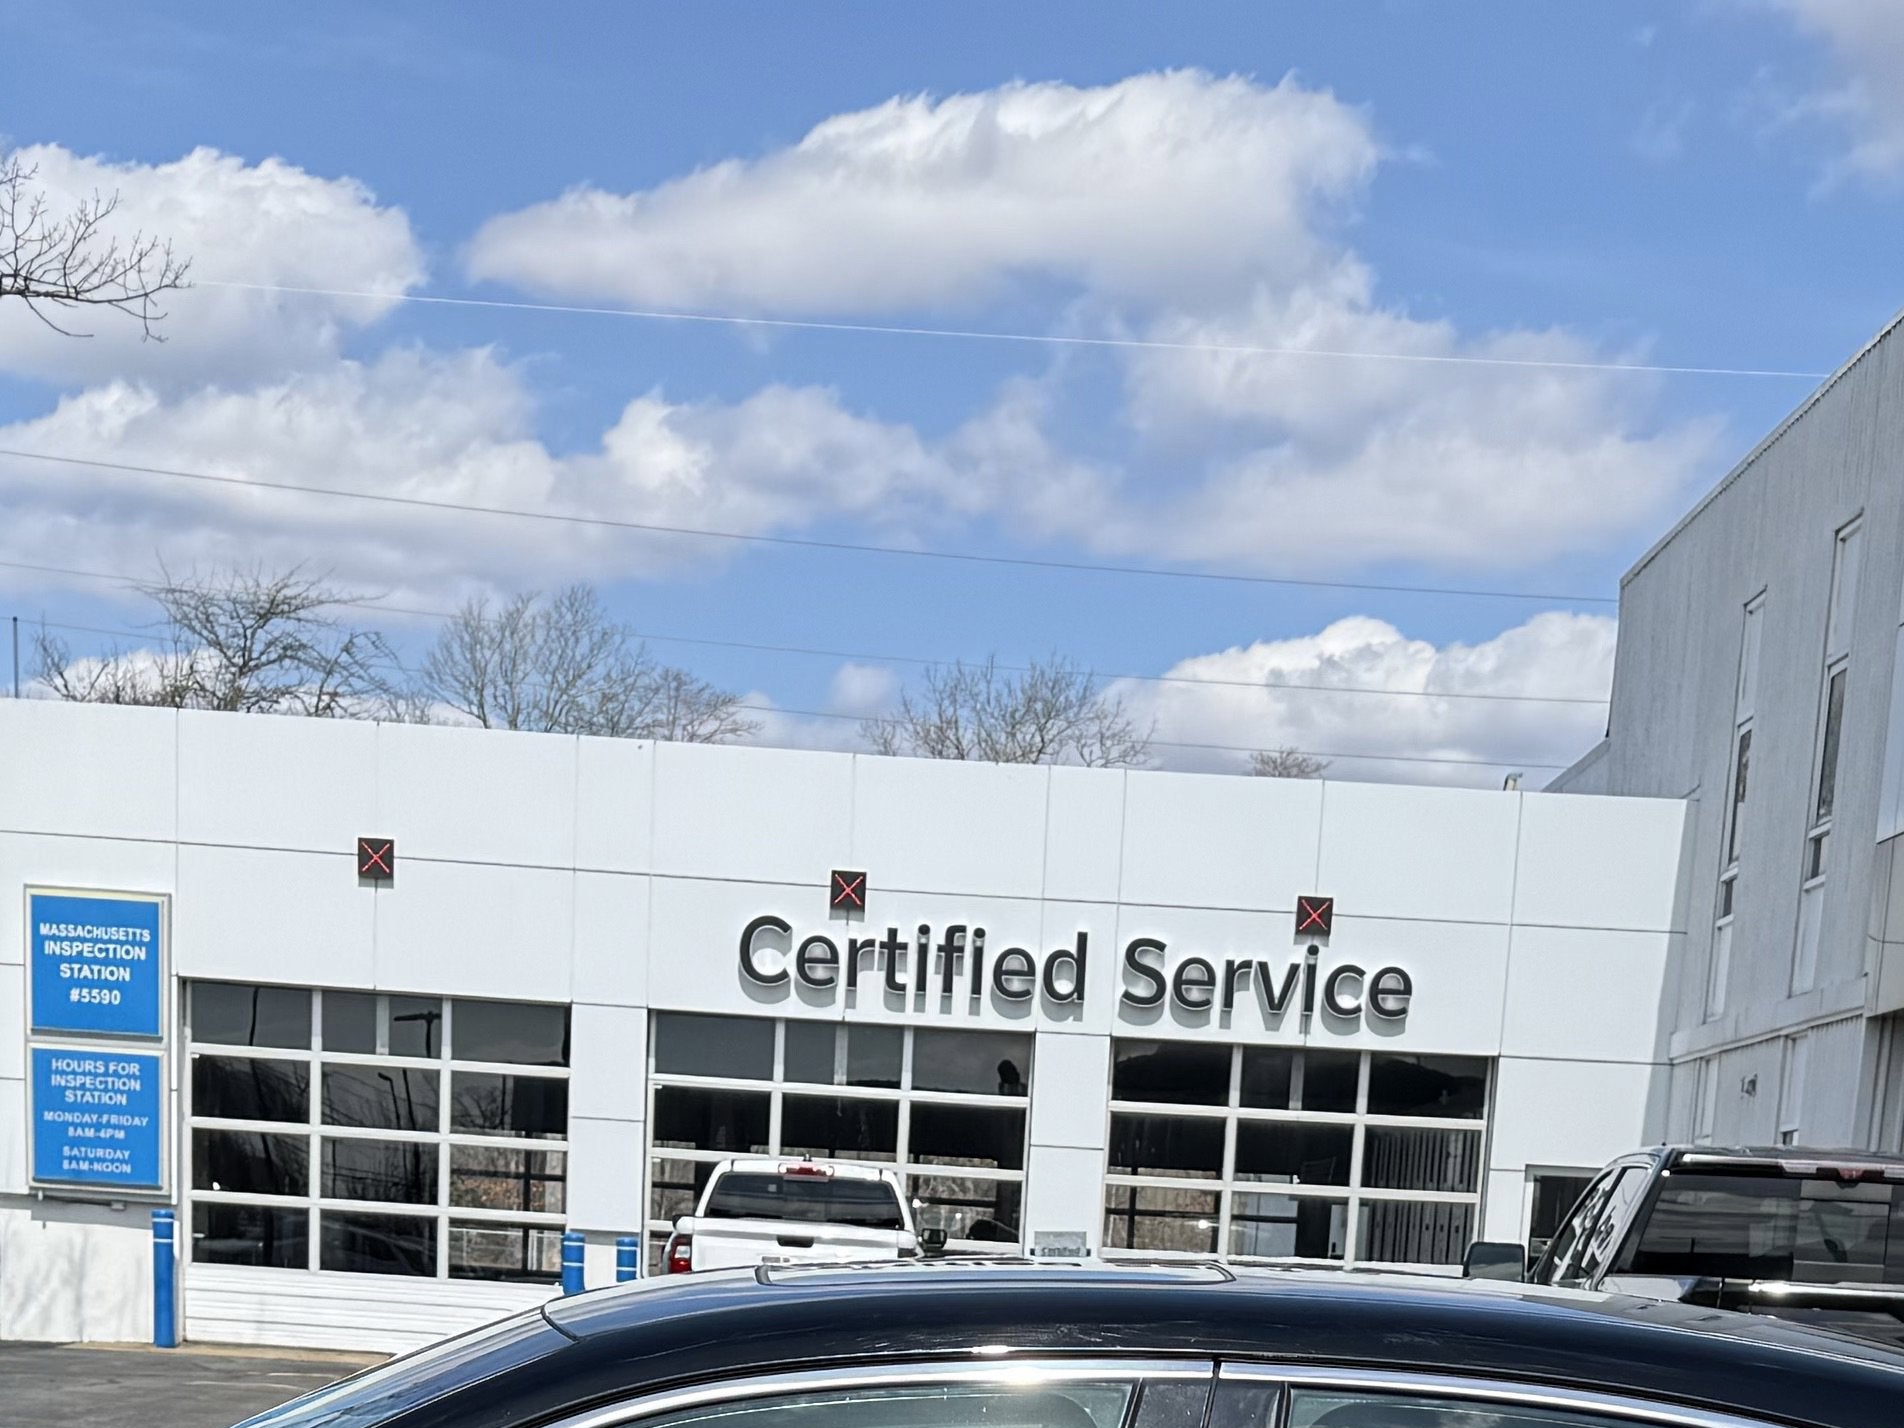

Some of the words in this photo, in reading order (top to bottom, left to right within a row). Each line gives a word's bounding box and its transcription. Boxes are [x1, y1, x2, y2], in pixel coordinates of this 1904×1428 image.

[39, 922, 151, 942] MASSACHUSETTS
[44, 940, 146, 961] INSPECTION
[59, 963, 131, 982] STATION
[738, 914, 1089, 1004] Certified
[1121, 937, 1414, 1020] Service
[69, 988, 121, 1006] #5590
[51, 1058, 106, 1074] HOURS
[108, 1062, 140, 1076] FOR
[51, 1075, 141, 1091] INSPECTION
[64, 1090, 127, 1106] STATION
[43, 1111, 149, 1127] MONDAY-FRIDAY
[62, 1146, 130, 1160] SATURDAY
